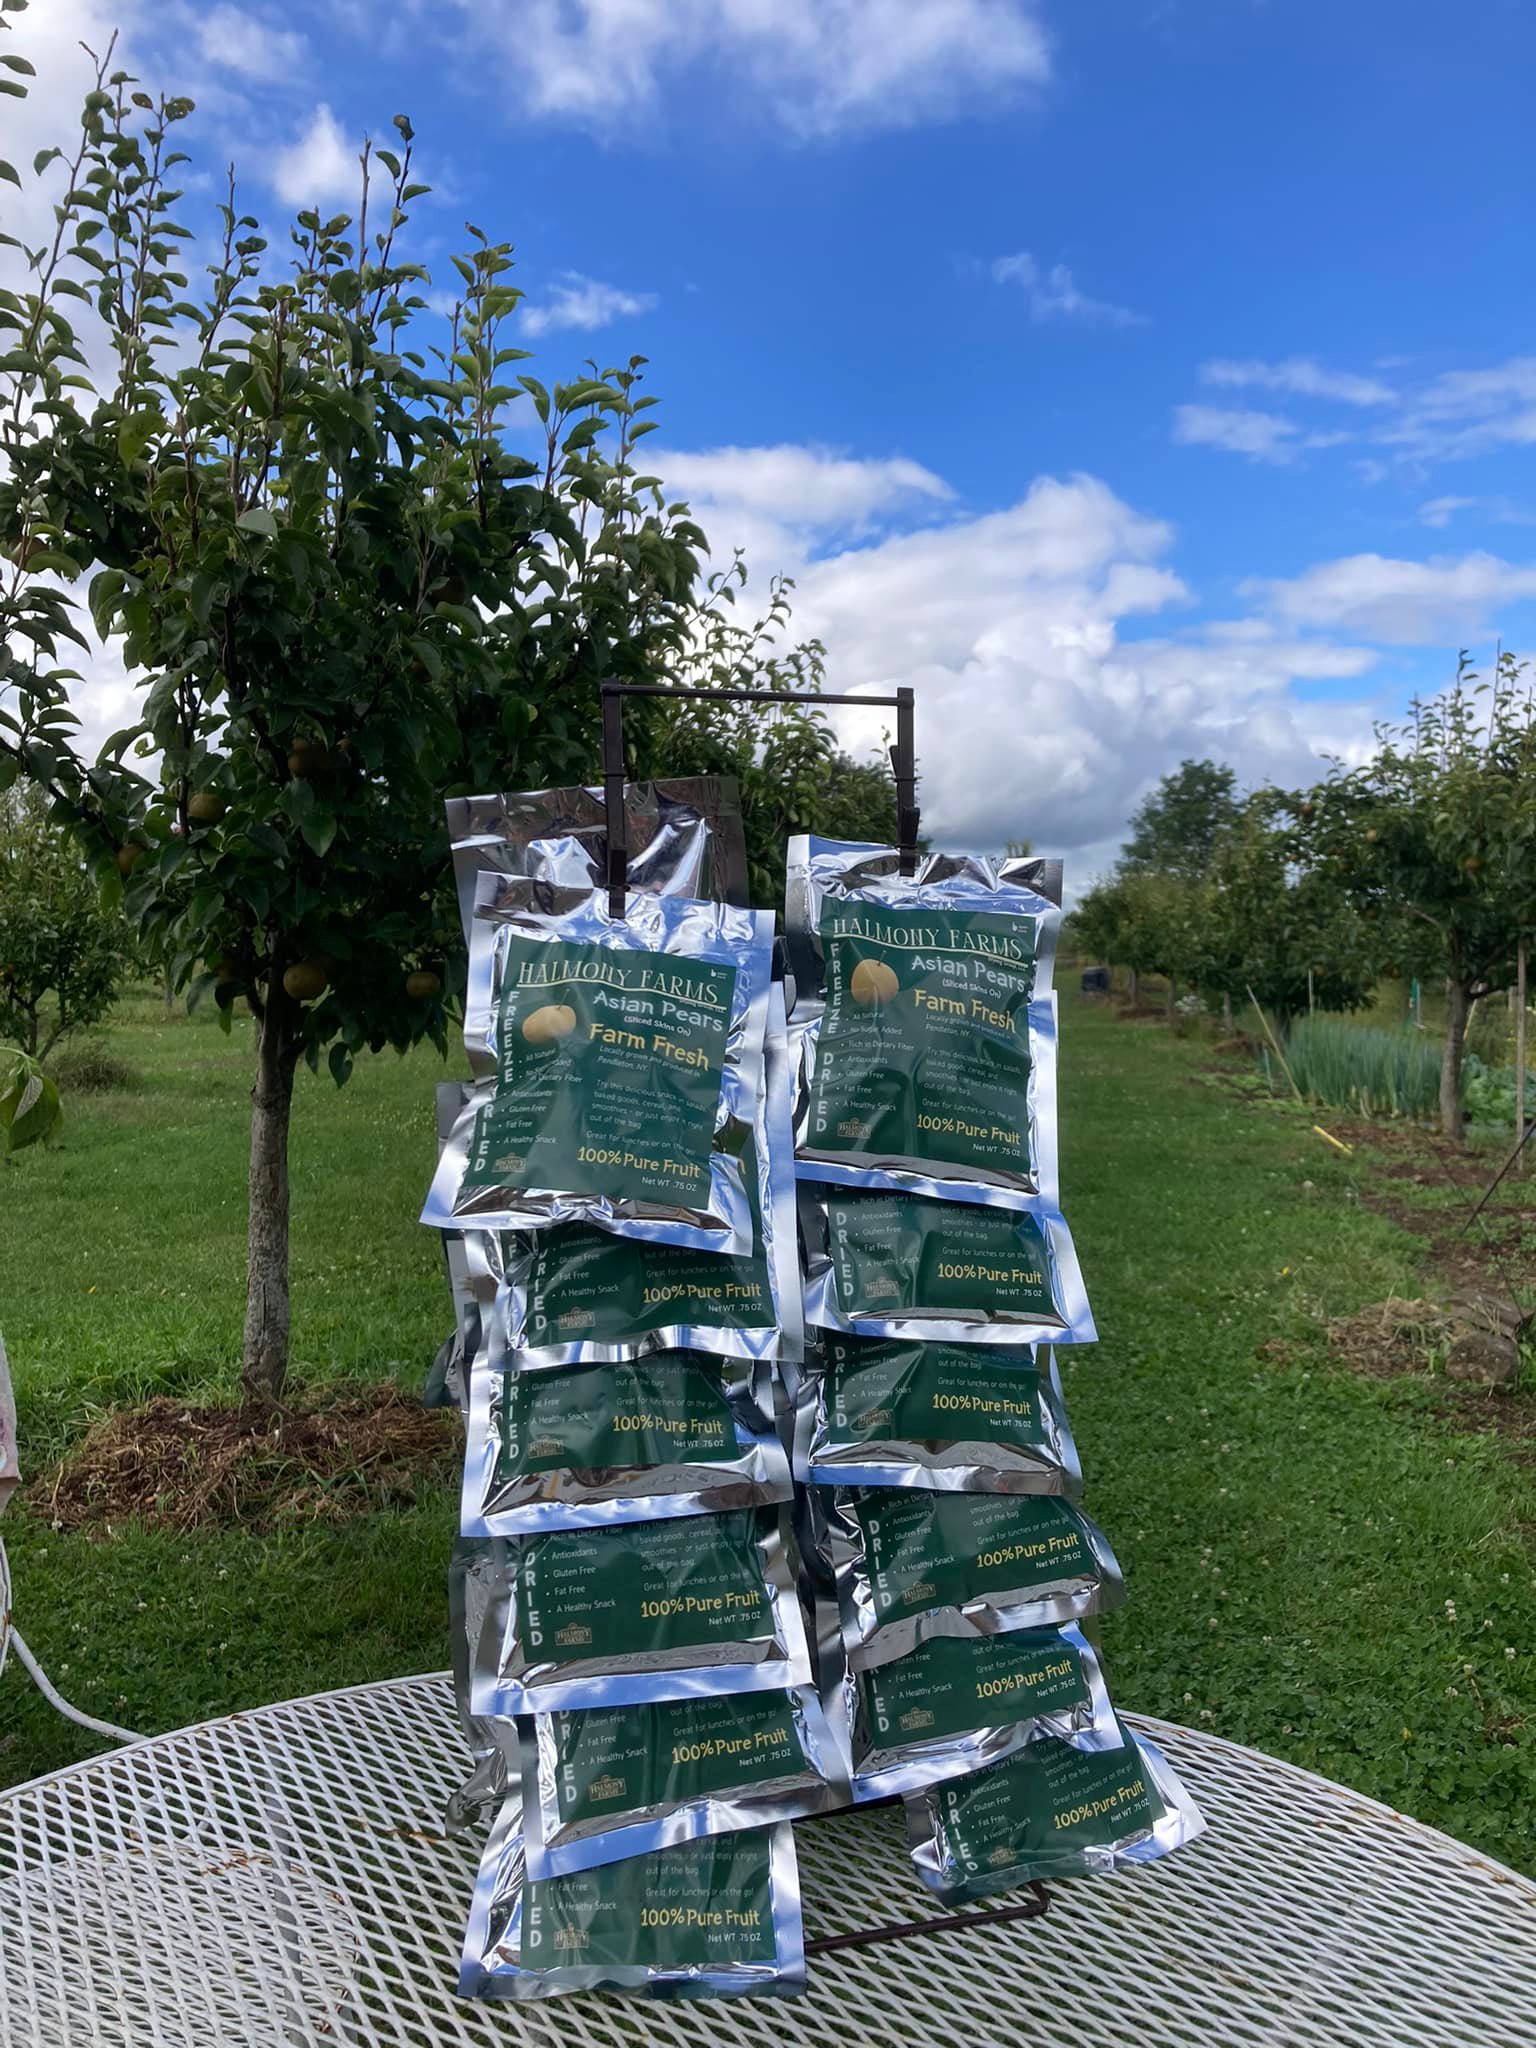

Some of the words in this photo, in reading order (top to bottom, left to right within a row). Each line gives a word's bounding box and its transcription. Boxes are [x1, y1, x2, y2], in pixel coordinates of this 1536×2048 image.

[833, 918, 940, 946] HALMONY
[949, 929, 1023, 961] FARMS
[517, 960, 632, 987] HALMONY
[640, 969, 720, 1004] FARMS
[912, 954, 967, 977] Asian
[975, 960, 1025, 993] Pears
[827, 943, 842, 1034] FREEZE
[942, 978, 967, 990] (Sliced
[969, 981, 987, 995] Skins
[988, 987, 1001, 999] On)
[593, 990, 654, 1014] Asian
[661, 999, 723, 1032] Pears
[914, 988, 966, 1015] Farm
[972, 999, 1016, 1034] Fresh
[504, 991, 521, 1082] FREEZE
[624, 1016, 652, 1028] (Sliced
[654, 1019, 675, 1033] Skins
[677, 1025, 692, 1037] On)
[589, 1024, 646, 1050] Farm
[653, 1035, 709, 1071] Fresh
[816, 1052, 834, 1132] DRIED
[916, 1114, 955, 1133] 100%
[956, 1120, 988, 1138] Pure
[991, 1125, 1021, 1145] Fruit
[973, 1143, 985, 1152] Net
[986, 1145, 998, 1154] WT
[1010, 1148, 1021, 1156] OZ
[577, 1146, 622, 1165] 100%
[623, 1154, 660, 1172] Pure
[663, 1158, 701, 1178] Fruit
[641, 1176, 655, 1186] Net
[656, 1178, 670, 1188] WT
[685, 1183, 697, 1192] OZ
[835, 1211, 854, 1297] DRIED
[864, 1243, 876, 1251] Fat
[877, 1242, 892, 1250] Free
[559, 1272, 571, 1280] Fat
[573, 1271, 590, 1279] Free
[937, 1264, 976, 1279] 100%
[978, 1266, 1008, 1283] Pure
[1012, 1268, 1042, 1284] Fruit
[561, 1289, 566, 1297] A
[568, 1286, 596, 1297] Healthy
[598, 1284, 620, 1294] Snack
[643, 1285, 686, 1304] 100%
[687, 1283, 722, 1299] Pure
[726, 1283, 762, 1298] Fruit
[995, 1288, 1008, 1296] Net
[1033, 1289, 1042, 1297] OZ
[708, 1304, 720, 1312] Net
[722, 1304, 735, 1312] WT
[835, 1346, 847, 1428] DRIED
[932, 1393, 971, 1409] 100%
[973, 1397, 1000, 1412] Pure
[1003, 1400, 1031, 1415] Fruit
[508, 1371, 520, 1458] DRIED
[613, 1415, 654, 1432] 100%
[655, 1417, 687, 1433] Pure
[691, 1419, 723, 1434] Fruit
[894, 1530, 915, 1542] Gluten
[916, 1526, 932, 1536] Free
[552, 1548, 598, 1560] Antioxidants
[897, 1548, 908, 1557] Fat
[909, 1545, 925, 1554] Free
[976, 1548, 1014, 1568] 100%
[1016, 1542, 1046, 1561] Pure
[1048, 1532, 1079, 1552] Fruit
[869, 1520, 892, 1607] DRIED
[908, 1560, 933, 1572] Healthy
[934, 1555, 955, 1565] Snack
[1035, 1561, 1048, 1569] Net
[1048, 1557, 1059, 1567] WT
[1072, 1552, 1082, 1560] OZ
[553, 1568, 576, 1578] Gluten
[578, 1565, 597, 1575] Free
[525, 1552, 543, 1646] DRIED
[554, 1586, 567, 1595] Fat
[568, 1584, 586, 1594] Free
[556, 1604, 563, 1612] A
[564, 1601, 592, 1613] Healthy
[593, 1599, 616, 1608] Snack
[641, 1598, 684, 1618] 100%
[686, 1597, 722, 1613] Pure
[726, 1590, 761, 1608] Fruit
[708, 1617, 721, 1625] Net
[722, 1615, 736, 1624] WT
[751, 1611, 761, 1619] OZ
[896, 1672, 906, 1680] Fat
[908, 1671, 923, 1680] Free
[975, 1678, 1014, 1698] 100%
[1016, 1672, 1044, 1690] Pure
[1045, 1660, 1073, 1680] Fruit
[906, 1686, 931, 1698] Healthy
[932, 1682, 952, 1692] Snack
[585, 1717, 607, 1729] Gluten
[609, 1713, 627, 1723] Free
[587, 1738, 600, 1746] Fat
[601, 1735, 617, 1744] Free
[671, 1743, 714, 1764] 100%
[716, 1737, 751, 1756] Pure
[754, 1727, 789, 1748] Fruit
[589, 1757, 596, 1765] A
[597, 1751, 624, 1764] Healthy
[625, 1746, 648, 1757] Snack
[739, 1758, 752, 1767] Net
[753, 1755, 766, 1764] WT
[781, 1749, 792, 1757] OZ
[1054, 1806, 1093, 1830] 100%
[1094, 1793, 1117, 1815] Pure
[1118, 1780, 1145, 1802] Fruit
[947, 1791, 978, 1871] DRIED
[640, 1908, 685, 1927] 100%
[687, 1911, 721, 1926] Pure
[725, 1909, 760, 1926] Fruit
[708, 1934, 722, 1943] Net
[724, 1934, 736, 1942] WT
[750, 1933, 761, 1941] OZ
